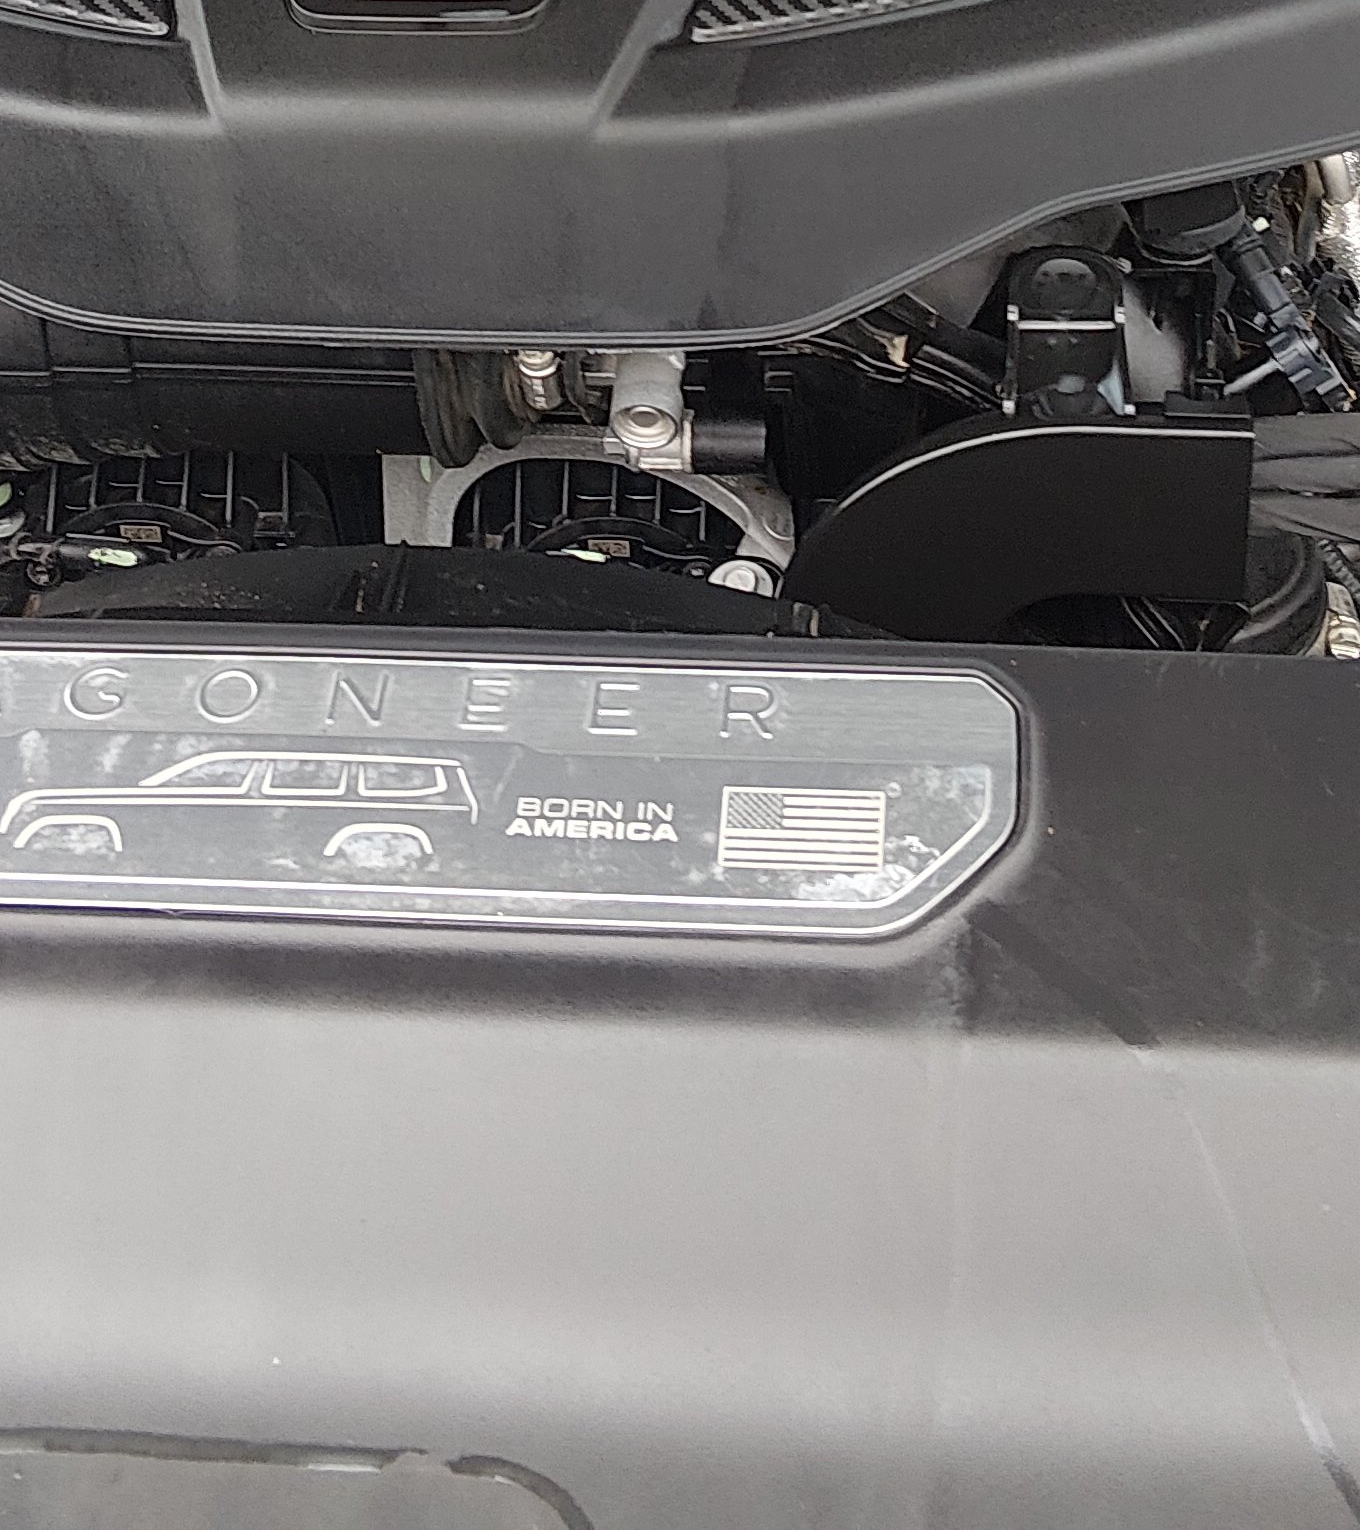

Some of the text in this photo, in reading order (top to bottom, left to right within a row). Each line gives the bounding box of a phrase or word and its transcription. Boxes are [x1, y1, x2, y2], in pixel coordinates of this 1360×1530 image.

[516, 796, 674, 822] BORN IN
[504, 817, 679, 843] AMERICA
